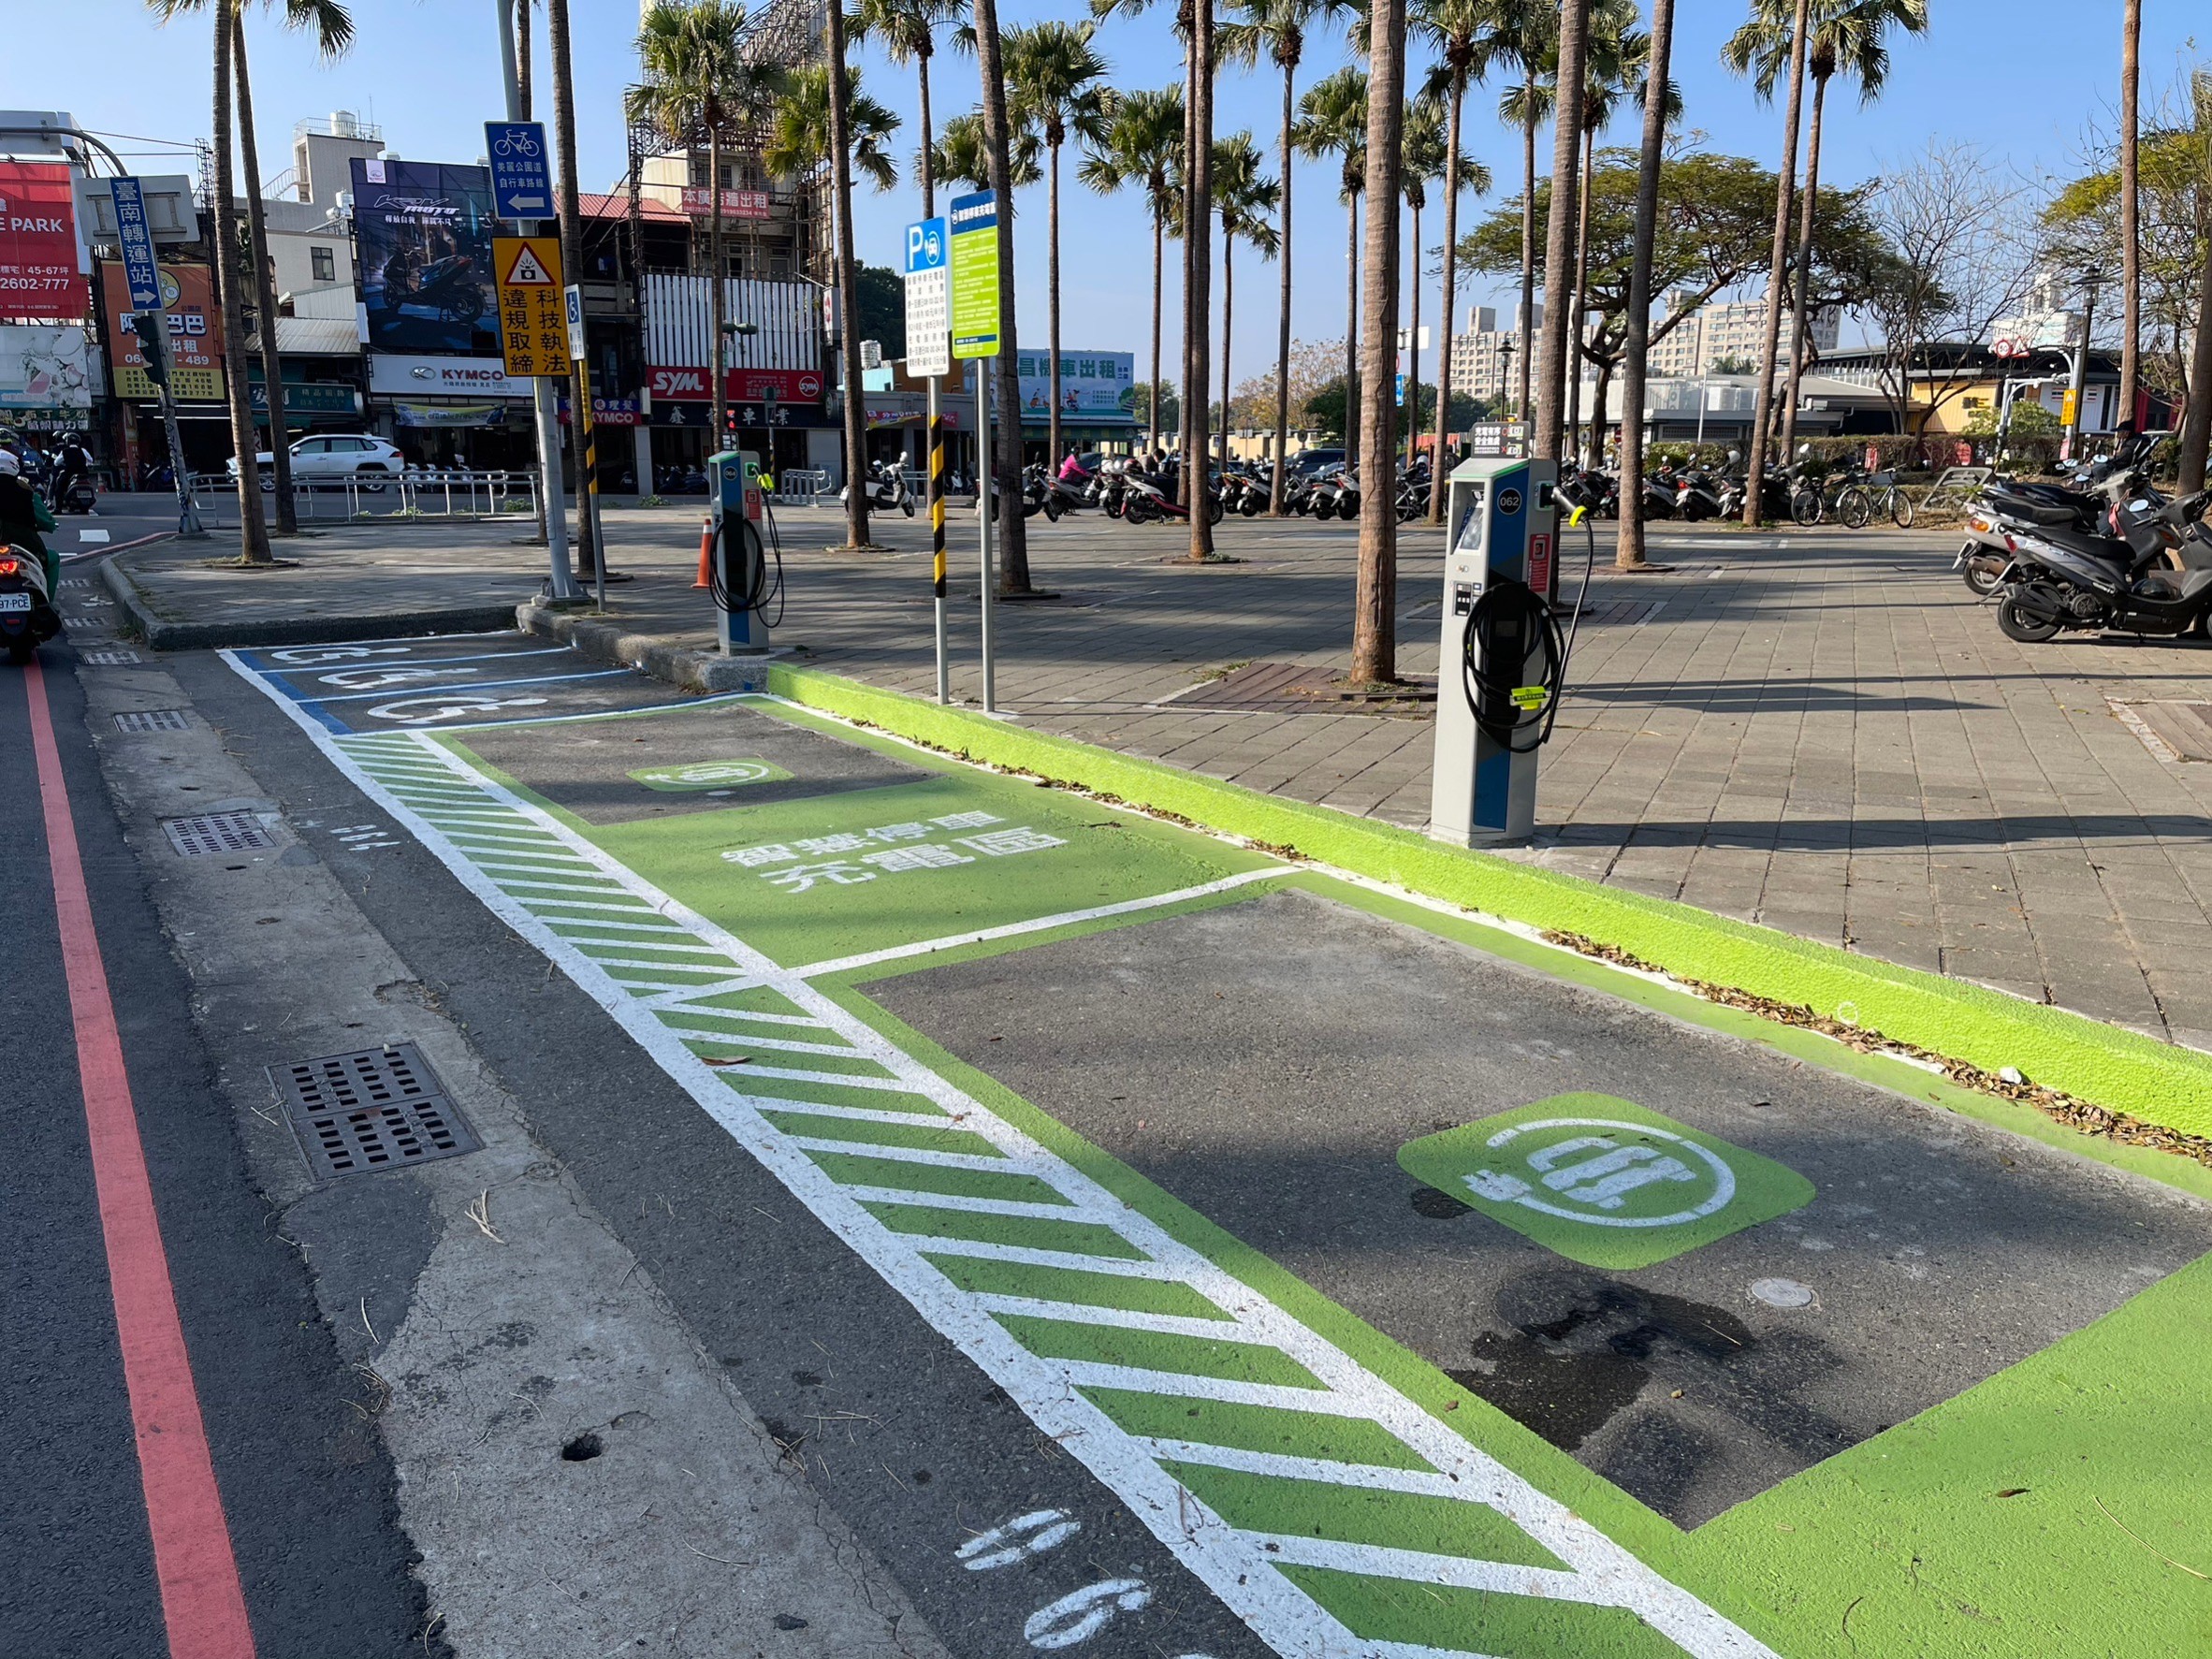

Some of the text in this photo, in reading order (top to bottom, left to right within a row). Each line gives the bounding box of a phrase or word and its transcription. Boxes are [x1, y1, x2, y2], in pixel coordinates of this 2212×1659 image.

[500, 178, 544, 188] 自行車路線
[10, 217, 64, 232] PARK
[114, 181, 153, 284] 臺南轉運站
[909, 226, 924, 270] P
[119, 313, 207, 334] 阿巴巴
[503, 288, 533, 372] 違規取締
[536, 288, 566, 372] 科技執法
[442, 369, 504, 380] KYMCO
[653, 371, 704, 396] SYM
[800, 382, 819, 392] SYM
[1500, 497, 1519, 507] 062
[720, 810, 1006, 866] 智慧停車
[759, 826, 1069, 894] 充電區
